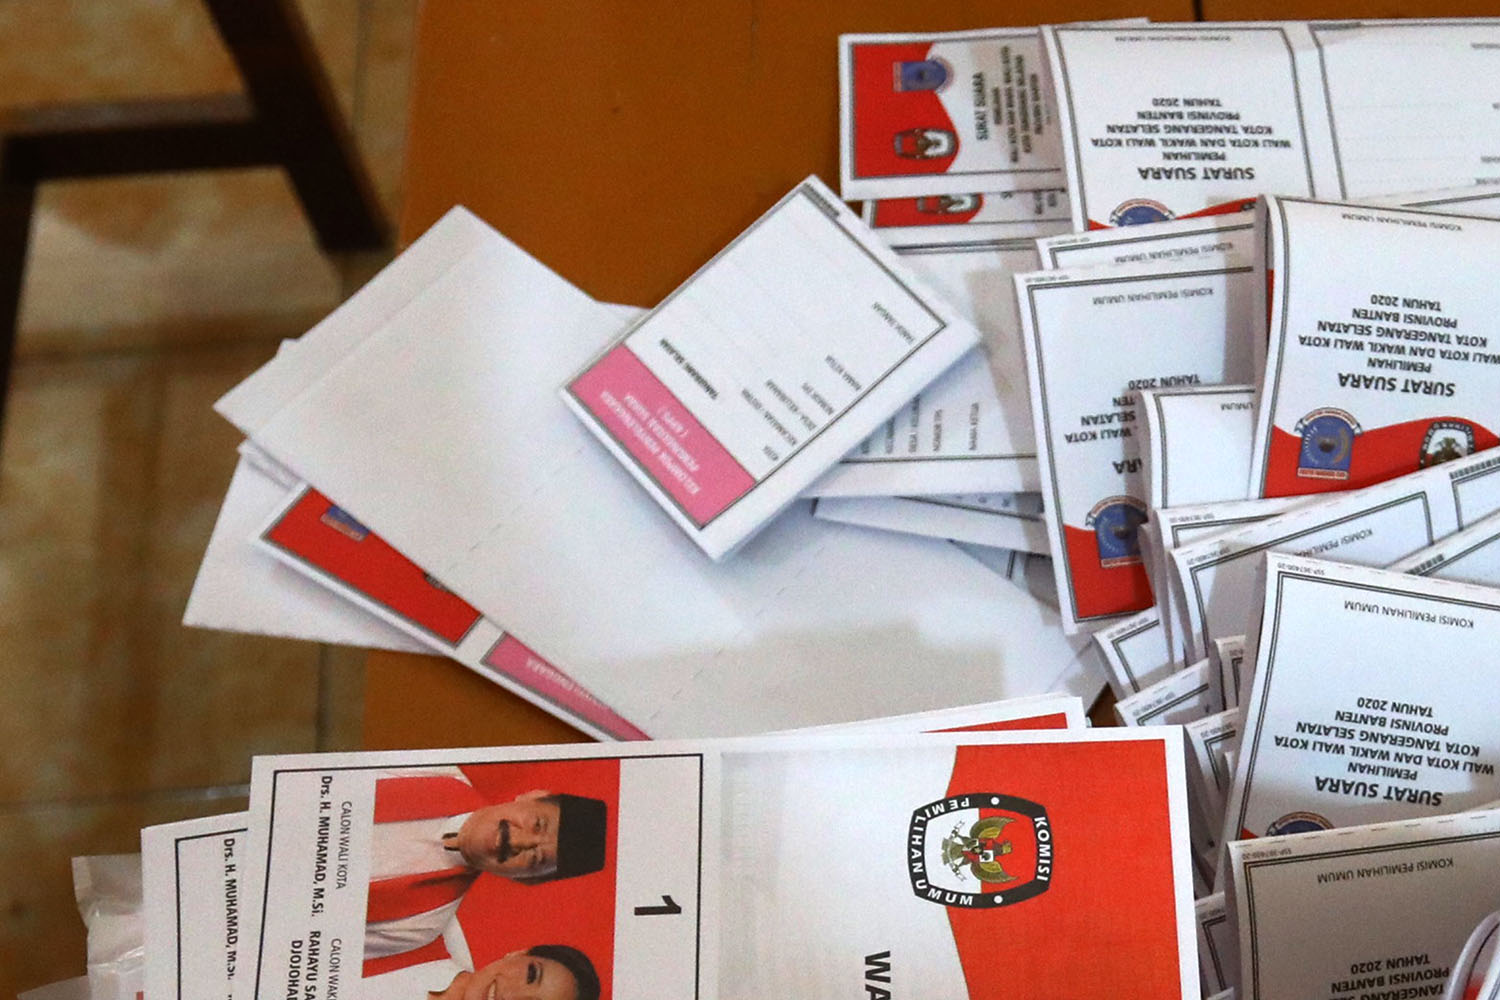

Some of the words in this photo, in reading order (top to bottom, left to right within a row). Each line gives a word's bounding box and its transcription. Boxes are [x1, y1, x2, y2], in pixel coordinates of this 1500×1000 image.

[1152, 98, 1179, 106] 2020
[1183, 98, 1222, 107] TAHUN
[1162, 152, 1226, 160] PEMILIHAN
[1138, 168, 1196, 180] SUARA
[1202, 167, 1255, 180] SURAT
[1371, 294, 1399, 308] 2020
[1402, 298, 1441, 312] TAHUN
[1352, 308, 1400, 323] BANTEN
[1403, 315, 1458, 328] PROVINSI
[1318, 321, 1372, 336] SELATAN
[1376, 327, 1452, 344] TANGERANG
[1298, 335, 1330, 348] KOTA
[1333, 339, 1364, 351] WALI
[1367, 342, 1406, 355] WAKIL
[1456, 335, 1487, 347] KOTA
[1410, 346, 1435, 358] DAN
[1439, 349, 1469, 361] KOTA
[1367, 357, 1431, 373] PEMILIHAN
[1128, 378, 1156, 390] 2020
[1160, 374, 1200, 388] TAHUN
[1338, 373, 1397, 392] SUARA
[1401, 378, 1456, 397] SURAT
[1080, 410, 1135, 425] SELATAN
[1064, 431, 1097, 443] KOTA
[1101, 427, 1132, 439] WALI
[1344, 601, 1379, 615] UMUM
[1382, 606, 1436, 624] PEMILIHAN
[1439, 615, 1474, 629] KOMISI
[1357, 697, 1388, 711] 2020
[1391, 702, 1434, 718] TAHUN
[1335, 711, 1387, 728] BANTEN
[1390, 718, 1449, 736] PROVINSI
[1296, 722, 1356, 740] SELATAN
[1274, 735, 1309, 750] KOTA
[1312, 741, 1345, 754] WALI
[1359, 731, 1441, 752] TANGERANG
[1350, 745, 1391, 761] WAKIL
[1446, 743, 1480, 757] KOTA
[1394, 752, 1423, 765] DAN
[1427, 756, 1460, 771] KOTA
[1348, 762, 1418, 780] PEMILIHAN
[1462, 762, 1494, 775] WALI
[320, 776, 333, 798] Drs.
[1315, 776, 1379, 798] SUARA
[1383, 785, 1443, 807] SURAT
[319, 802, 331, 813] H.
[340, 801, 352, 834] CALON
[912, 797, 969, 873] PEMILIHAN
[224, 839, 236, 861] Drs.
[313, 816, 330, 885] MUHAMAD,
[338, 836, 349, 861] WALI
[1034, 817, 1051, 881] KOMISI
[225, 864, 237, 876] H.
[1356, 863, 1414, 879] PEMILIHAN
[1417, 858, 1454, 872] KOMISI
[336, 864, 348, 889] KOTA
[1317, 870, 1354, 883] UMUM
[916, 879, 973, 906] UMUM
[311, 888, 325, 917] M.Si.
[634, 895, 682, 916] 1
[224, 879, 238, 948] MUHAMAD,
[305, 931, 321, 981] RAHAYU
[329, 938, 342, 973] CALON
[1386, 954, 1430, 971] TAHUN
[1350, 959, 1382, 975] 2020
[1389, 967, 1450, 987] PROVINSI
[1331, 976, 1385, 994] BANTEN
